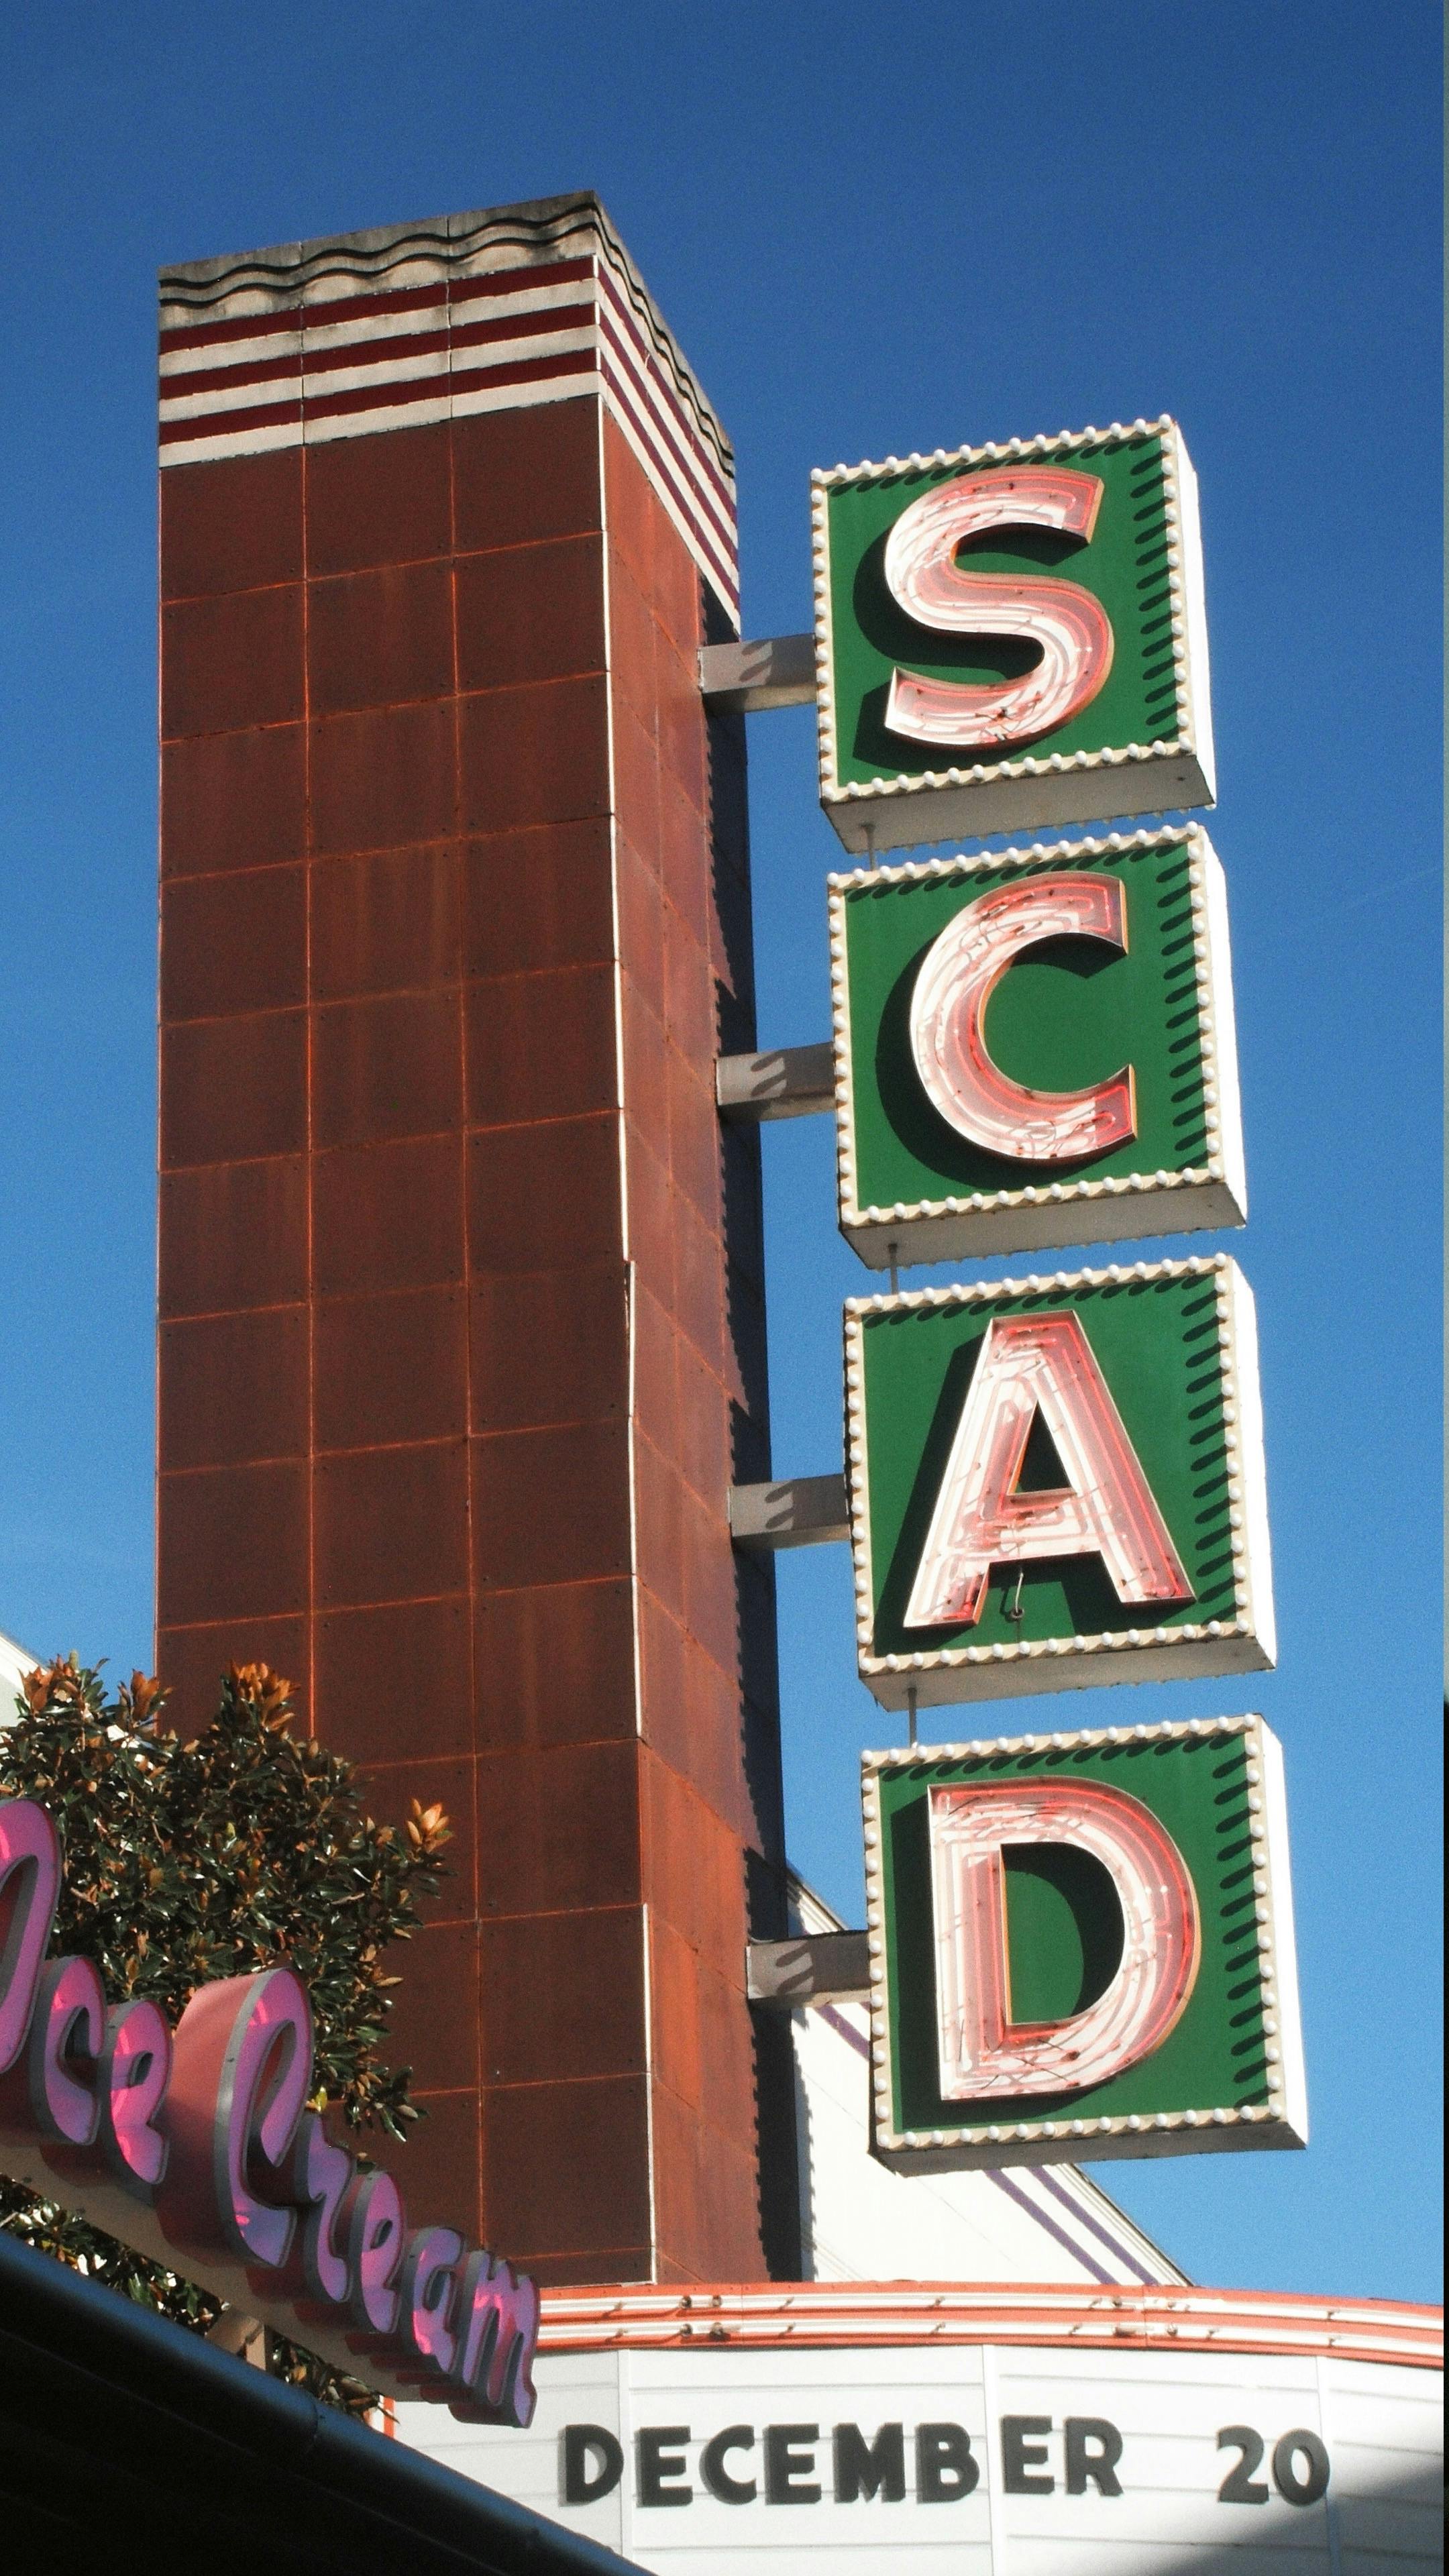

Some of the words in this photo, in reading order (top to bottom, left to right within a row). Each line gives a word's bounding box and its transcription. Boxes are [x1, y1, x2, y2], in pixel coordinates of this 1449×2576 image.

[884, 464, 1202, 2101] SCAD
[215, 1967, 540, 2428] Cream
[561, 2414, 1124, 2507] DECEMBER
[1216, 2424, 1331, 2507] 20
